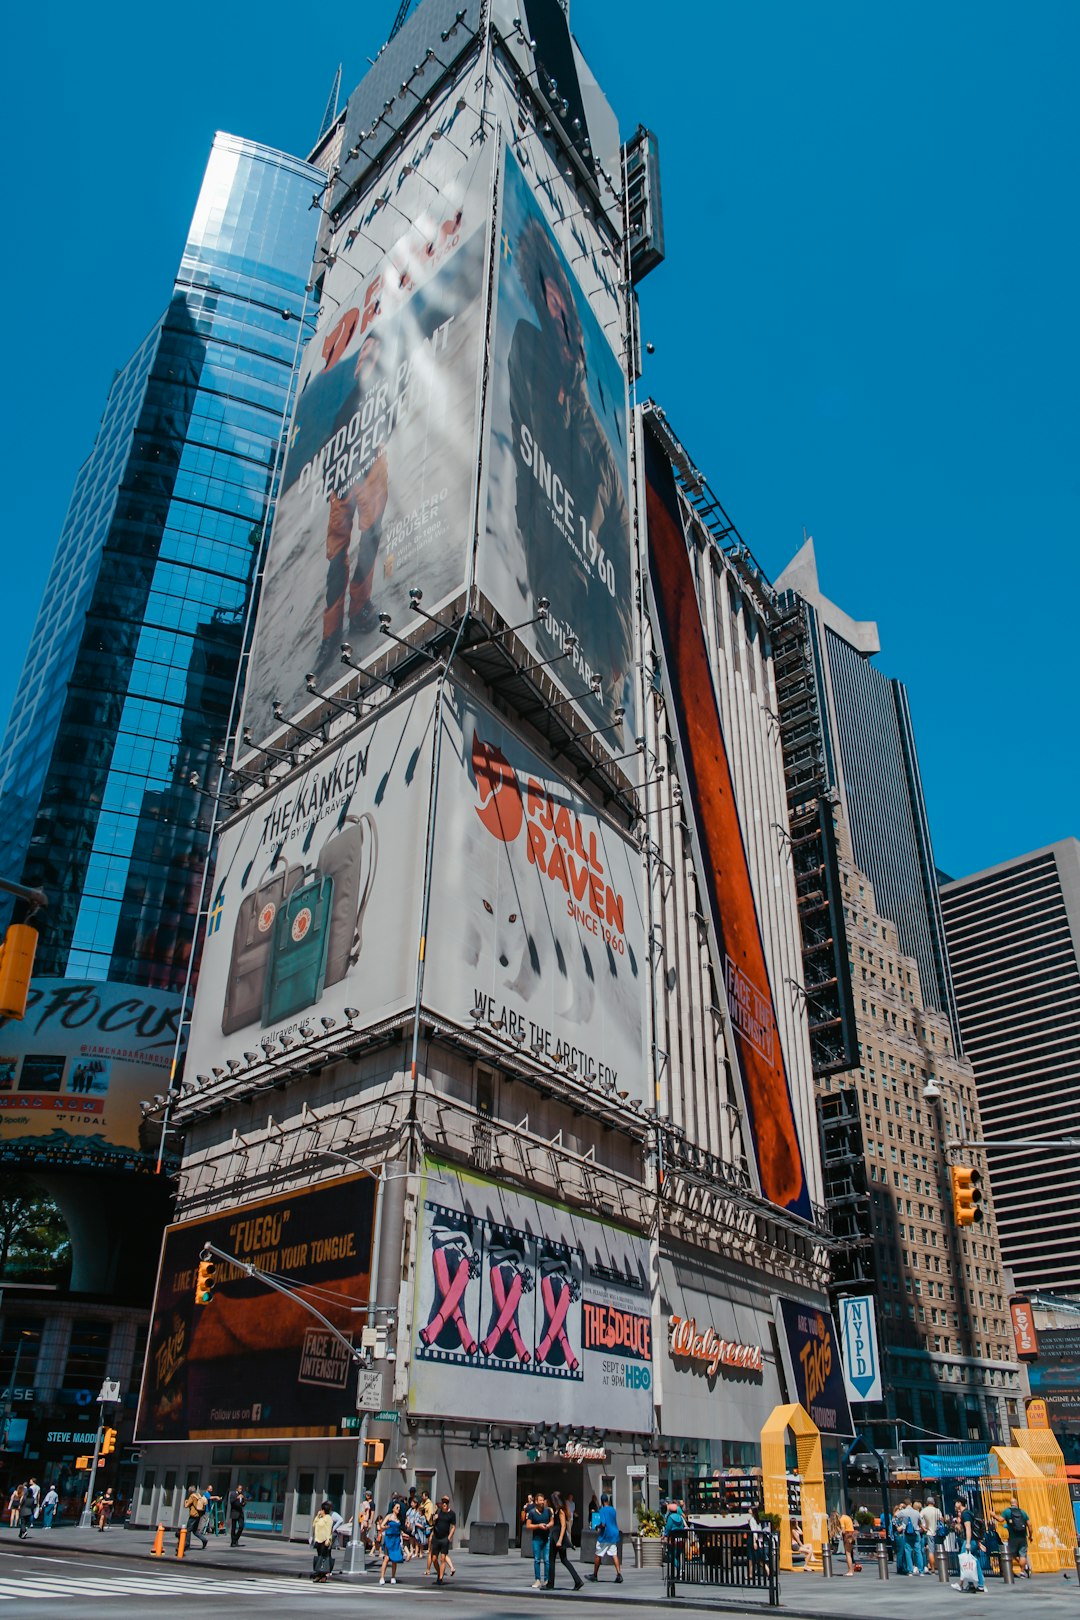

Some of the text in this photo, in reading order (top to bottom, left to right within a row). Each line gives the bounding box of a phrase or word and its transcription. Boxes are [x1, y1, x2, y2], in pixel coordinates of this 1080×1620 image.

[297, 382, 389, 495] OUTDOOR
[420, 487, 448, 514] PRO
[520, 423, 616, 598] SINCE 1960
[385, 505, 439, 556] TROUSER
[263, 745, 370, 846] THE KÅNKEN
[290, 823, 303, 841] BY
[526, 776, 604, 876] FJÄLL
[526, 819, 625, 935] RÄVEN
[566, 900, 625, 956] SINCE 1960
[34, 984, 193, 1051] FOCUS
[727, 964, 771, 1034] FACE THE
[728, 990, 772, 1057] INTENSITY
[474, 988, 619, 1095] WE ARE THE ARCTIC FOX
[4, 1114, 107, 1126] Spotify TIDAL
[172, 1268, 191, 1292] LIKE
[253, 1251, 279, 1277] WITH
[281, 1242, 307, 1271] YOUR
[310, 1232, 357, 1265] TONGUE.
[304, 1333, 329, 1358] FACE
[583, 1303, 652, 1361] THE DEUCE
[669, 1315, 764, 1376] Walgreens
[797, 1314, 808, 1334] ARE
[851, 1304, 867, 1377] NYPD
[301, 1357, 348, 1382] INTENSITY
[602, 1360, 626, 1376] SEPT 9
[603, 1374, 625, 1388] AT 9PM
[625, 1364, 651, 1391] HBO
[47, 1432, 71, 1443] STEVE
[210, 1408, 232, 1420] Follow
[232, 1410, 241, 1419] us
[241, 1409, 251, 1419] on
[811, 1405, 837, 1430] ENOUGH?
